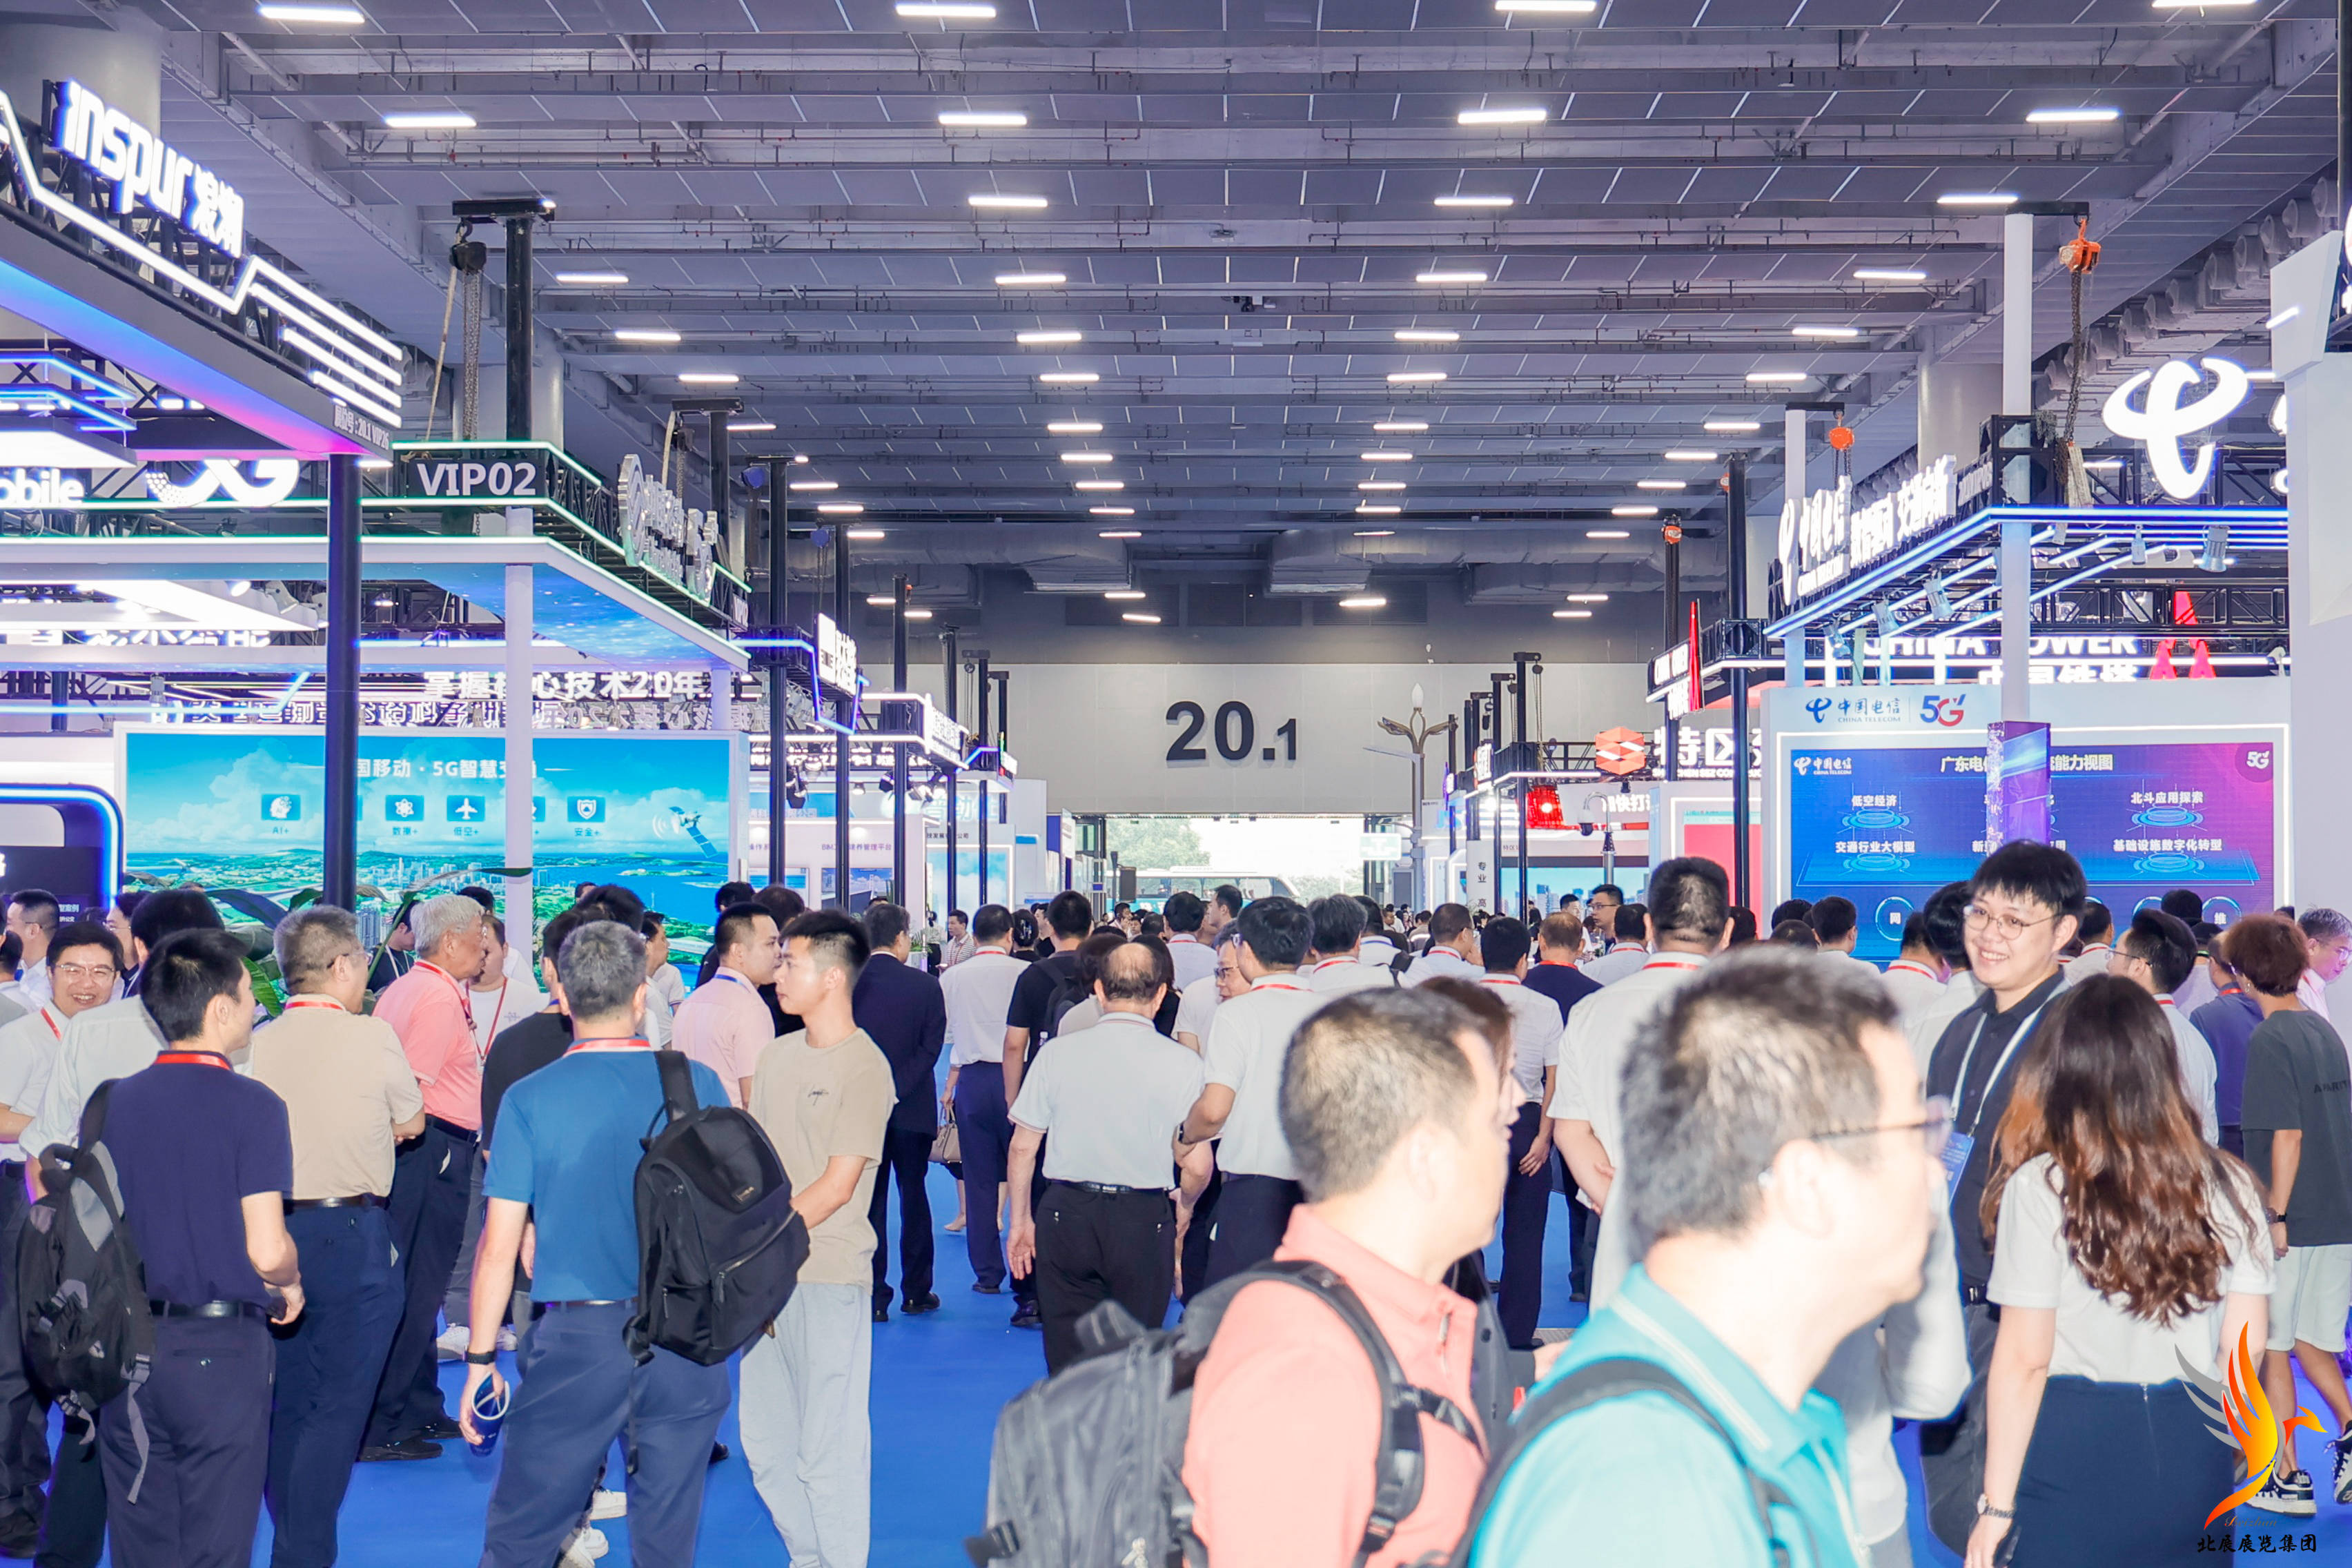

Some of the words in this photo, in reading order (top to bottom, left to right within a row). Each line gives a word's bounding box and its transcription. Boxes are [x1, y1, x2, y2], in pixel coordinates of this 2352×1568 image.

[61, 78, 194, 215] inspur
[417, 462, 536, 496] VIP02
[1838, 698, 1900, 716] 中国电信
[1920, 694, 1966, 727] 5G
[1166, 700, 1297, 761] 20.1
[357, 758, 537, 778] 国移动·5G智慧
[1813, 757, 1852, 770] 中国电信
[2246, 751, 2270, 769] 5G
[1851, 795, 1897, 807] 低空经济
[2130, 792, 2204, 804] 北斗应用探索
[1834, 841, 1916, 854] 交通行业大模型
[2113, 839, 2223, 852] 基础设施数字化转型
[1478, 861, 1487, 883] 专业
[1889, 912, 1901, 924] 网
